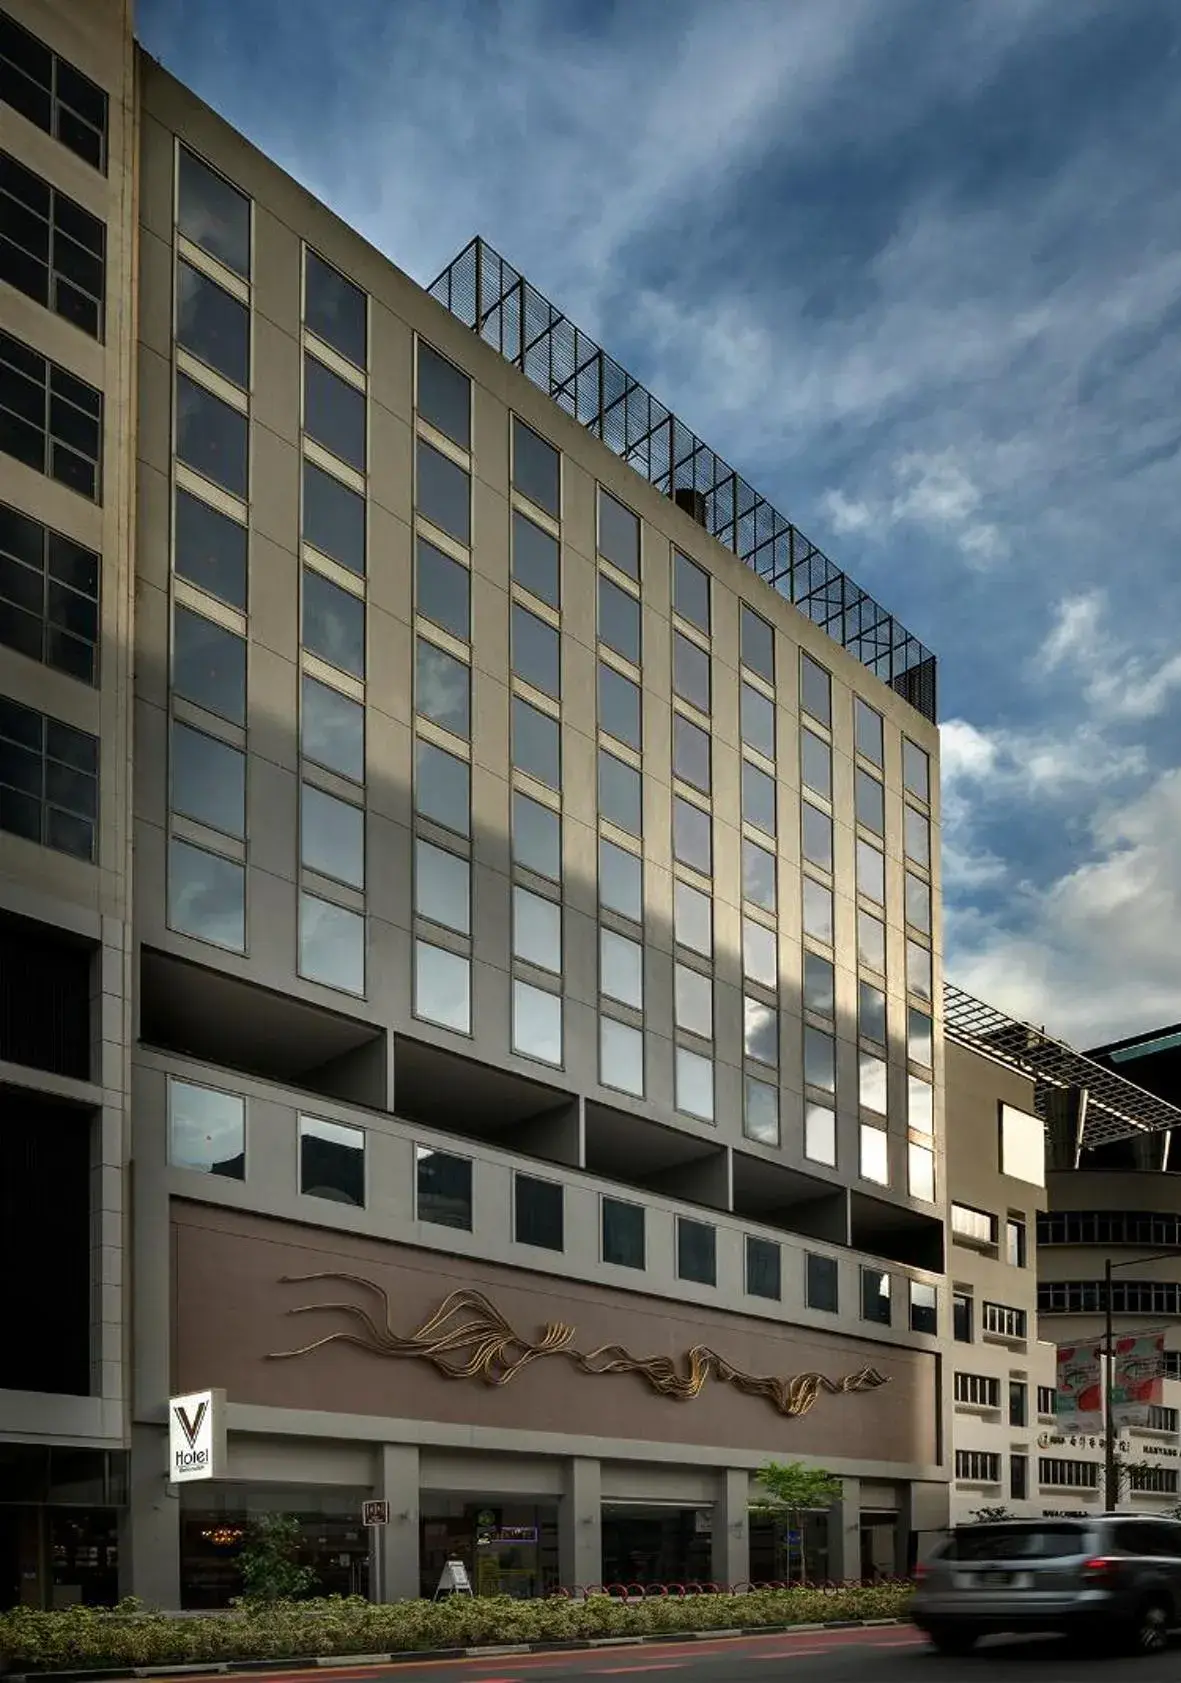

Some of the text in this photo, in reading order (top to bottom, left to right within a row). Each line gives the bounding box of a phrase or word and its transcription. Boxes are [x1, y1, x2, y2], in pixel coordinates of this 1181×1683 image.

[173, 1399, 209, 1449] V
[175, 1448, 209, 1466] Hotel
[1143, 1445, 1177, 1456] NANYANG
